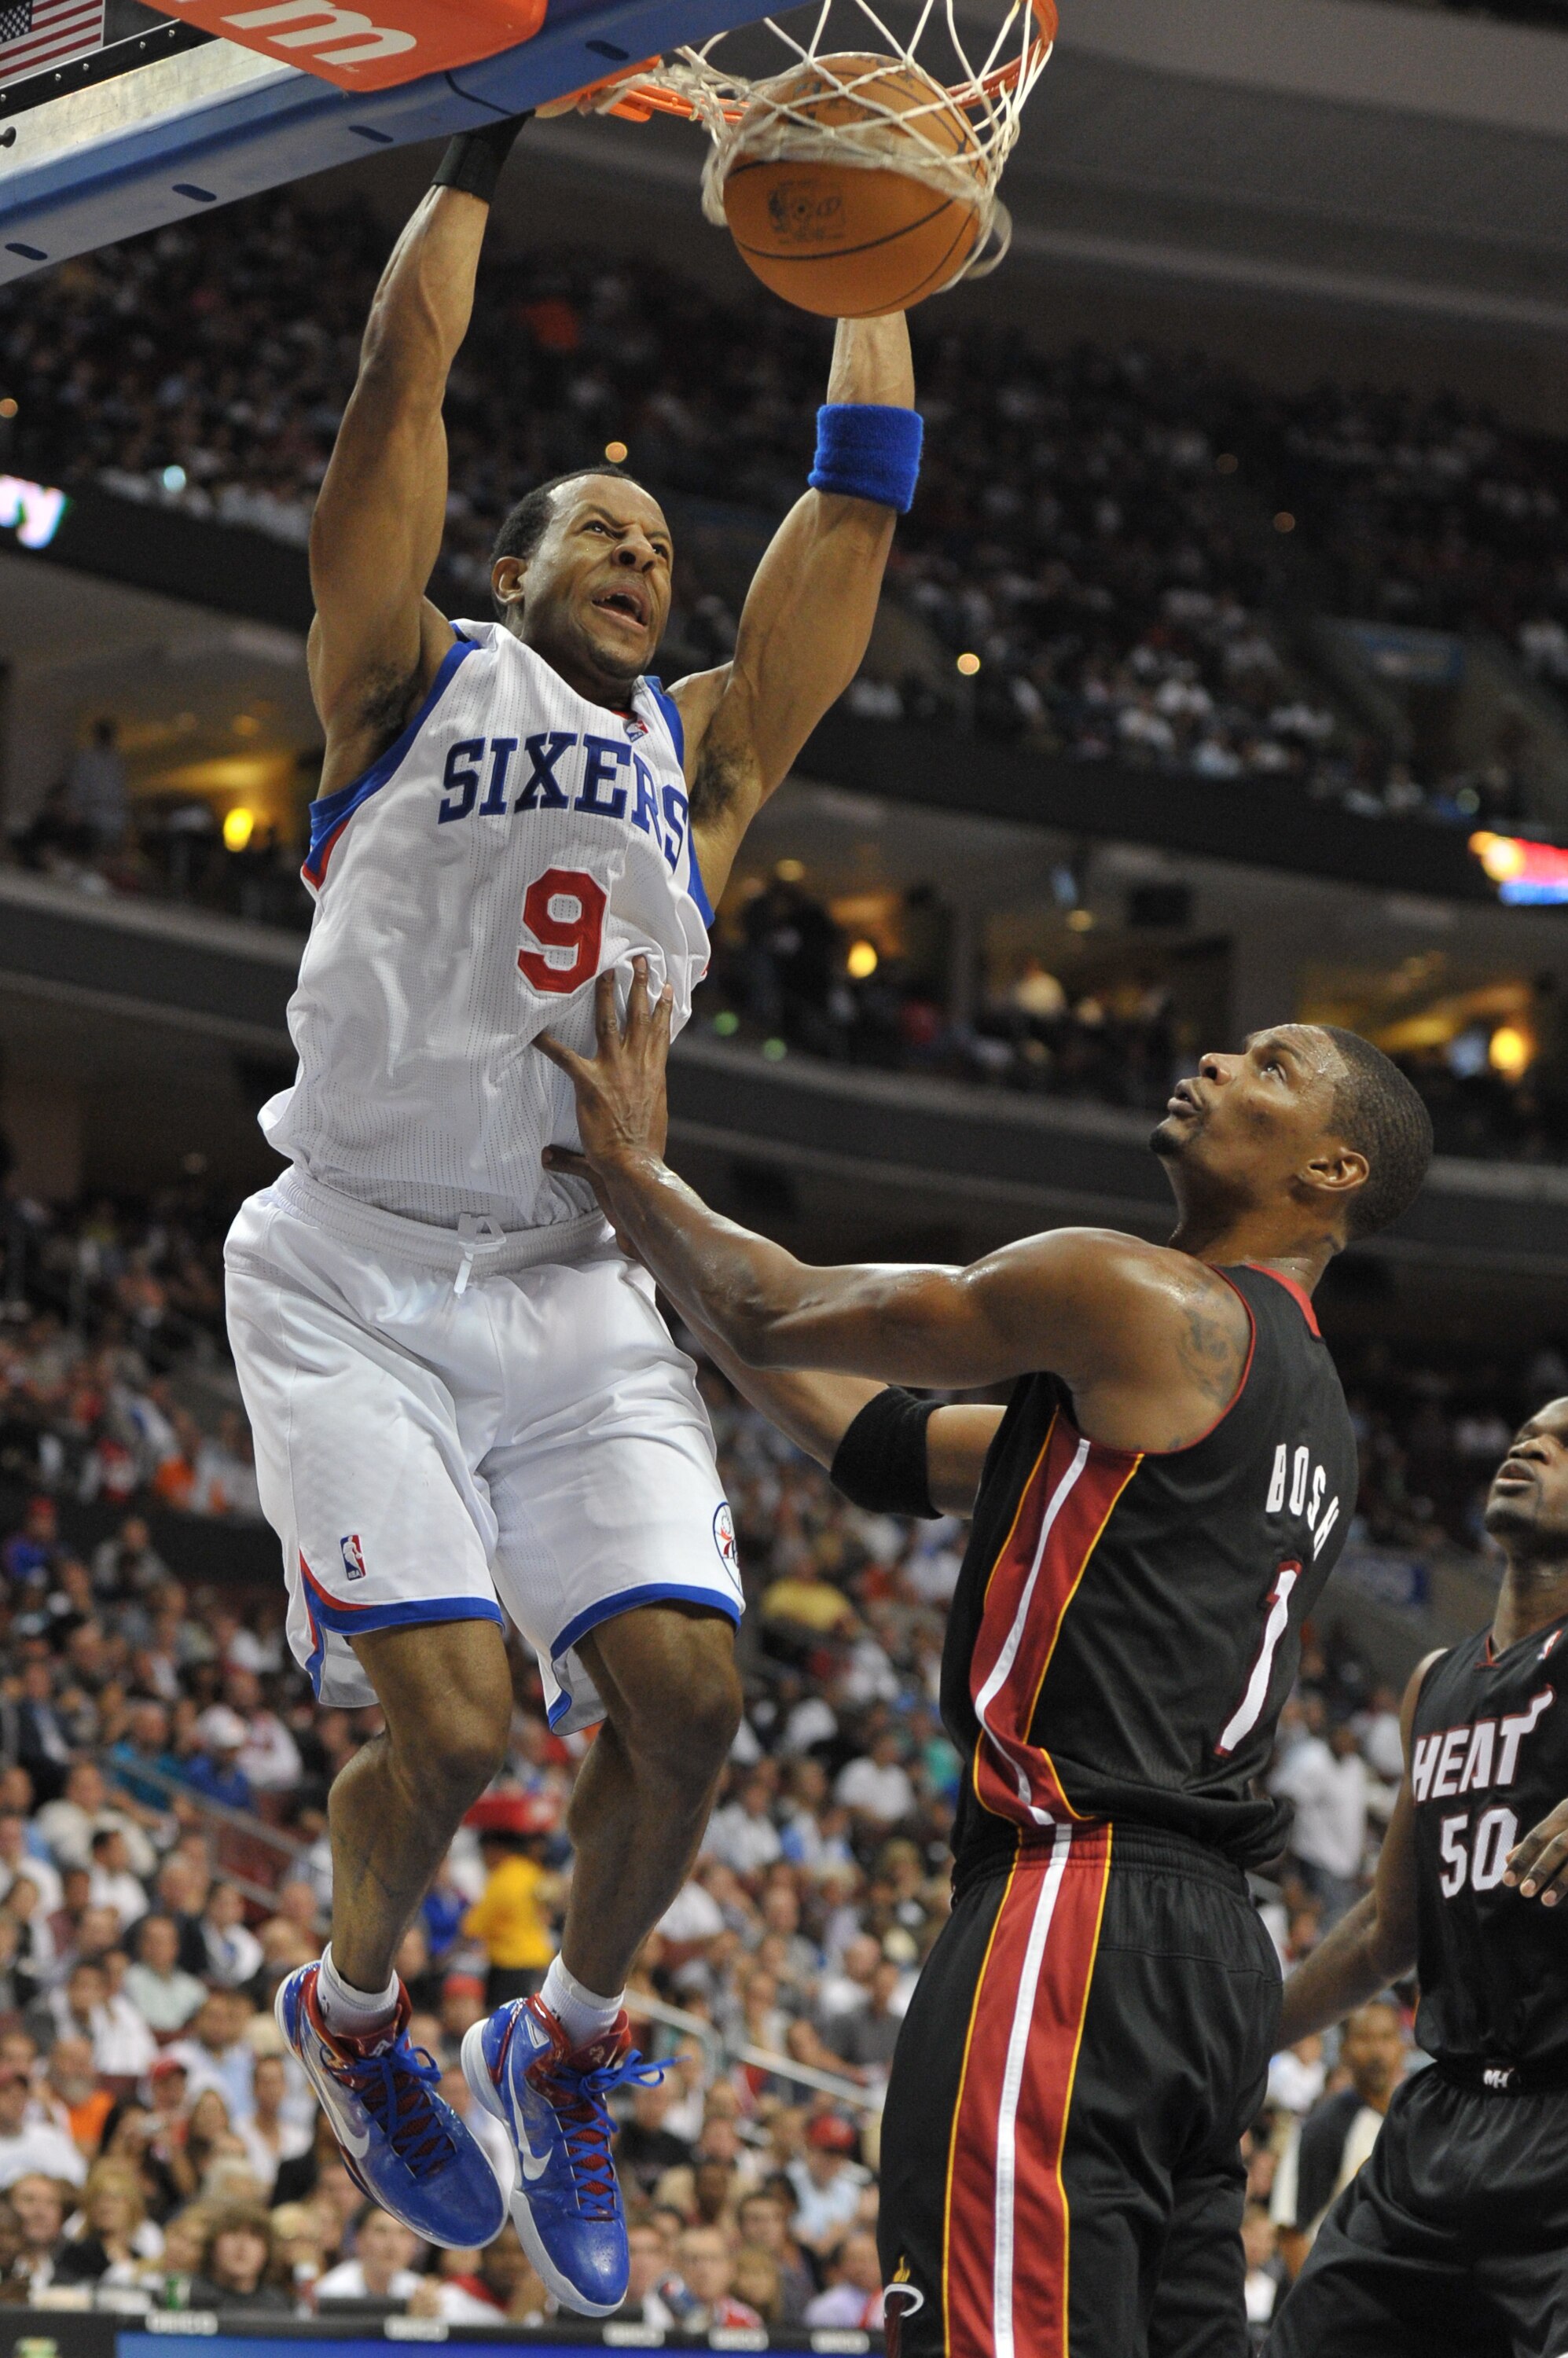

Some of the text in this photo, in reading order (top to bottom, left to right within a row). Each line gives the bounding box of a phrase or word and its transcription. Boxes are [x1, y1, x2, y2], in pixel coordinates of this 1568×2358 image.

[174, 0, 417, 65] m
[438, 731, 689, 875] SIXERS
[518, 868, 608, 995] 9
[1265, 1443, 1340, 1562] BOSH
[1217, 1561, 1301, 1754] 1
[1412, 1688, 1555, 1803] HEAT
[1440, 1807, 1519, 1899] 50
